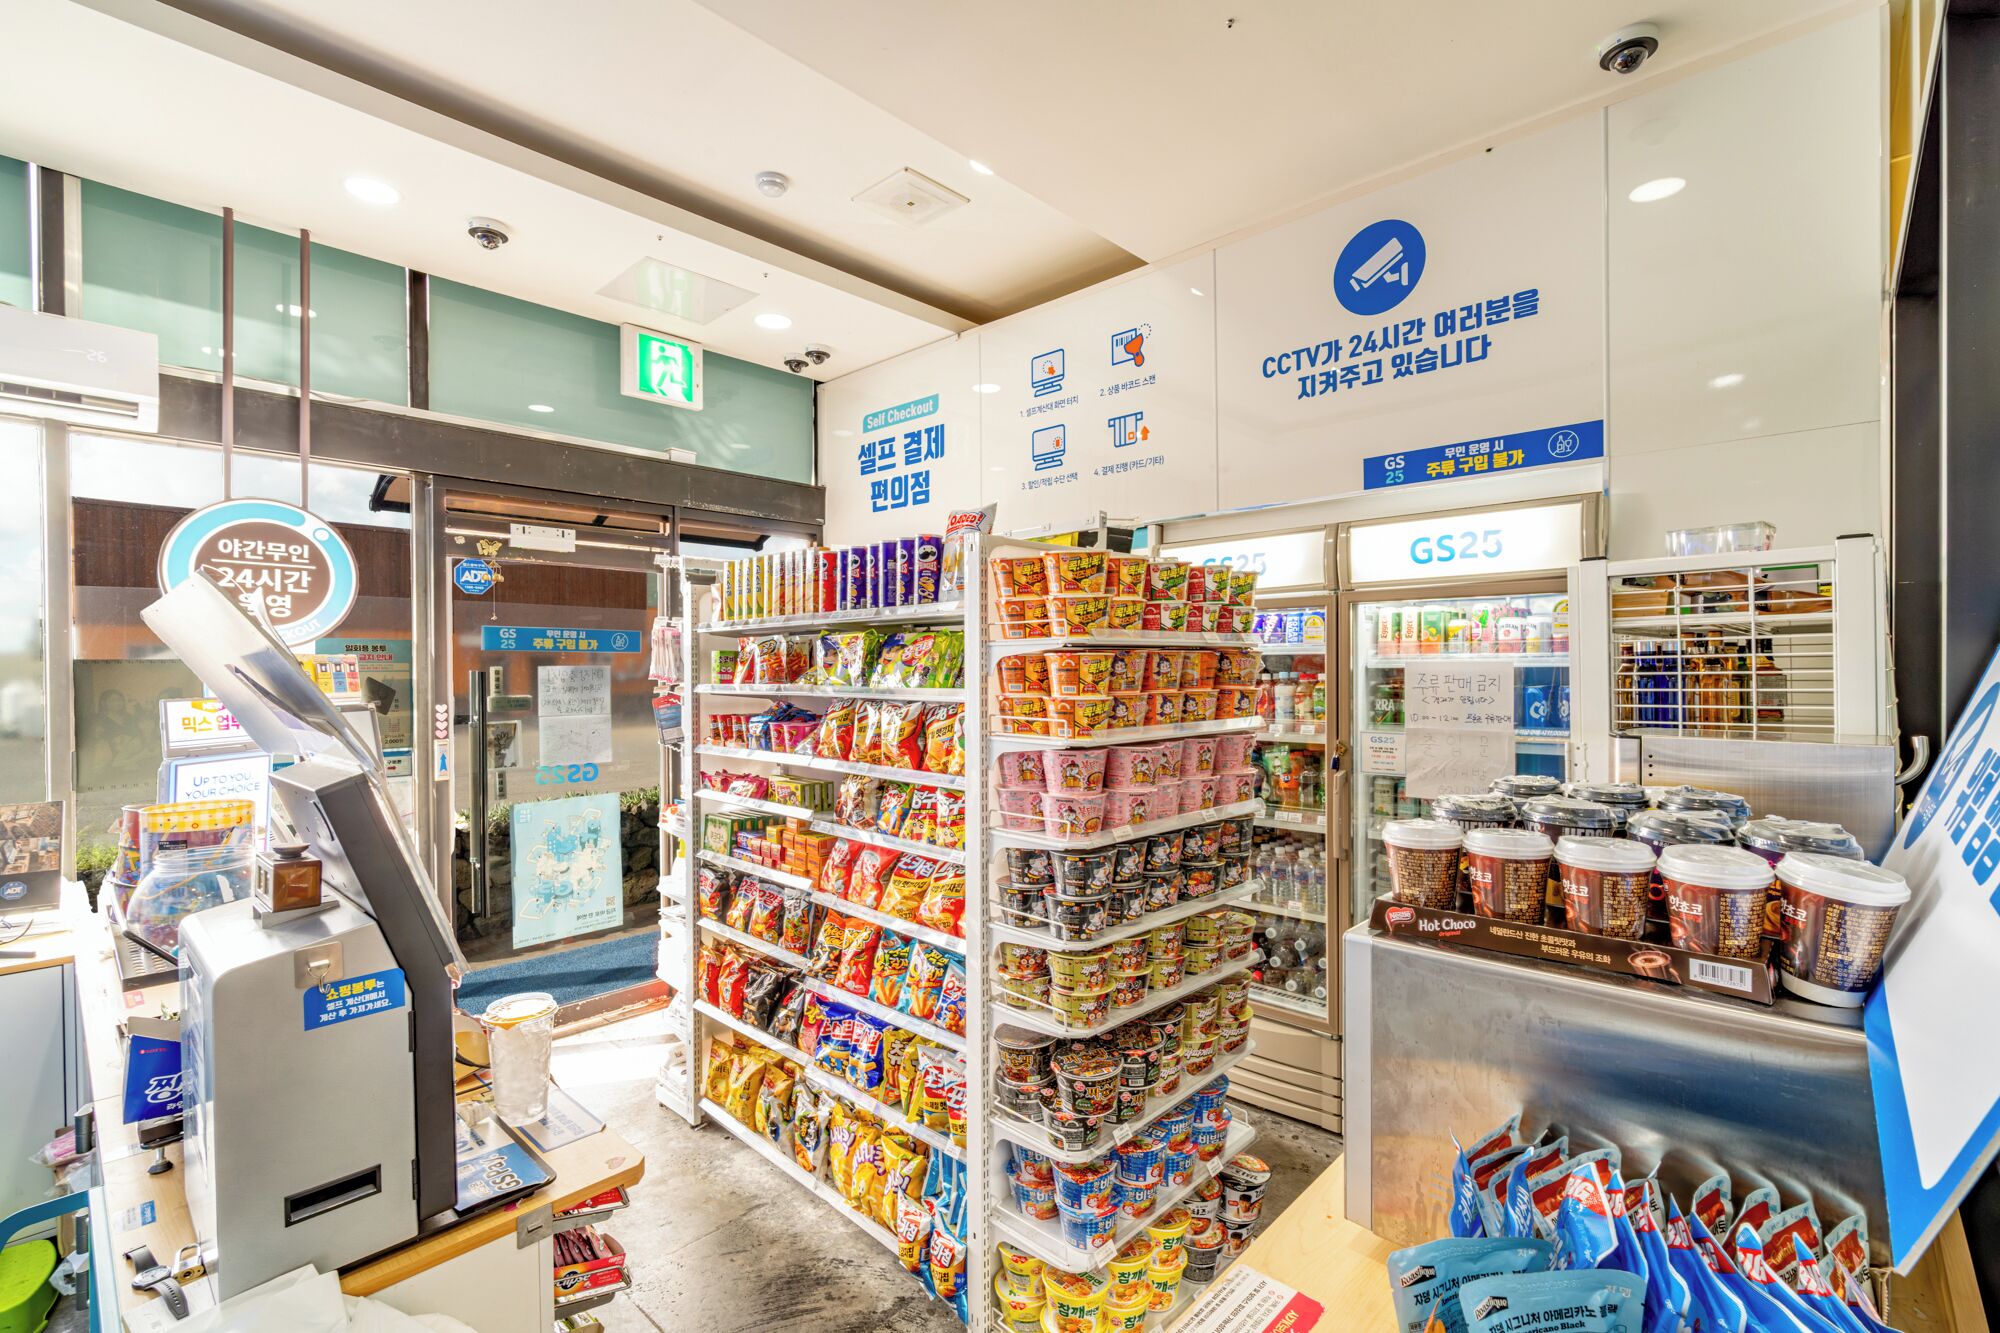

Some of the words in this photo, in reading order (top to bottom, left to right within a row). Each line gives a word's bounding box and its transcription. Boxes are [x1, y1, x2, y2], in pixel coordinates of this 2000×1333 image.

[1262, 339, 1343, 379] CCTV가
[1348, 317, 1427, 359] 24시간
[1434, 288, 1540, 338] 여러분을
[1297, 358, 1384, 400] 지켜주고
[1391, 333, 1492, 380] 있습니다
[1107, 383, 1120, 397] 상품
[1121, 378, 1142, 392] 바코드
[1142, 374, 1156, 386] 스캔
[867, 411, 885, 429] Self
[887, 400, 933, 423] Checkout
[1026, 402, 1054, 417] 셀프계산대
[1054, 399, 1066, 409] 화면
[1067, 395, 1079, 406] 터치
[858, 436, 897, 475] 셀프
[904, 423, 945, 466] 결제
[1445, 446, 1466, 459] 무인
[1468, 442, 1490, 455] 운영
[1493, 439, 1504, 451] 시
[1102, 464, 1115, 476] 결제
[1115, 461, 1128, 474] 진행
[1384, 455, 1405, 470] GS
[1426, 460, 1456, 478] 주류
[1459, 455, 1488, 473] 구입
[1493, 448, 1525, 469] 불가
[1385, 470, 1405, 484] 25
[871, 469, 930, 513] 편의점
[217, 538, 310, 564] 야간무인
[1410, 529, 1503, 565] GS25
[216, 566, 312, 593] 24시간
[499, 628, 517, 639] GS
[500, 640, 516, 649] 25
[533, 638, 554, 649] 주류
[556, 639, 576, 650] 구입
[1412, 672, 1441, 695] 주류
[1444, 675, 1472, 693] 판매
[1476, 674, 1501, 693] 금지
[182, 716, 213, 732] 믹스
[1668, 894, 1704, 917] 핫초코
[1418, 919, 1440, 932] Hot
[1443, 917, 1476, 931] Choco
[1489, 925, 1524, 940] 네덜란드산
[1524, 930, 1539, 941] 진한
[1541, 944, 1570, 957] 부드러운
[1571, 949, 1594, 962] 우유의
[1595, 952, 1611, 965] 조화
[326, 978, 385, 1001] 쇼핑봉투는
[319, 1012, 337, 1023] 계산
[338, 1009, 347, 1018] 후
[1506, 1311, 1542, 1331] 시그니처
[1543, 1305, 1597, 1324] 아메리카노
[1599, 1304, 1618, 1317] 블랙
[1560, 1320, 1586, 1330] Black
